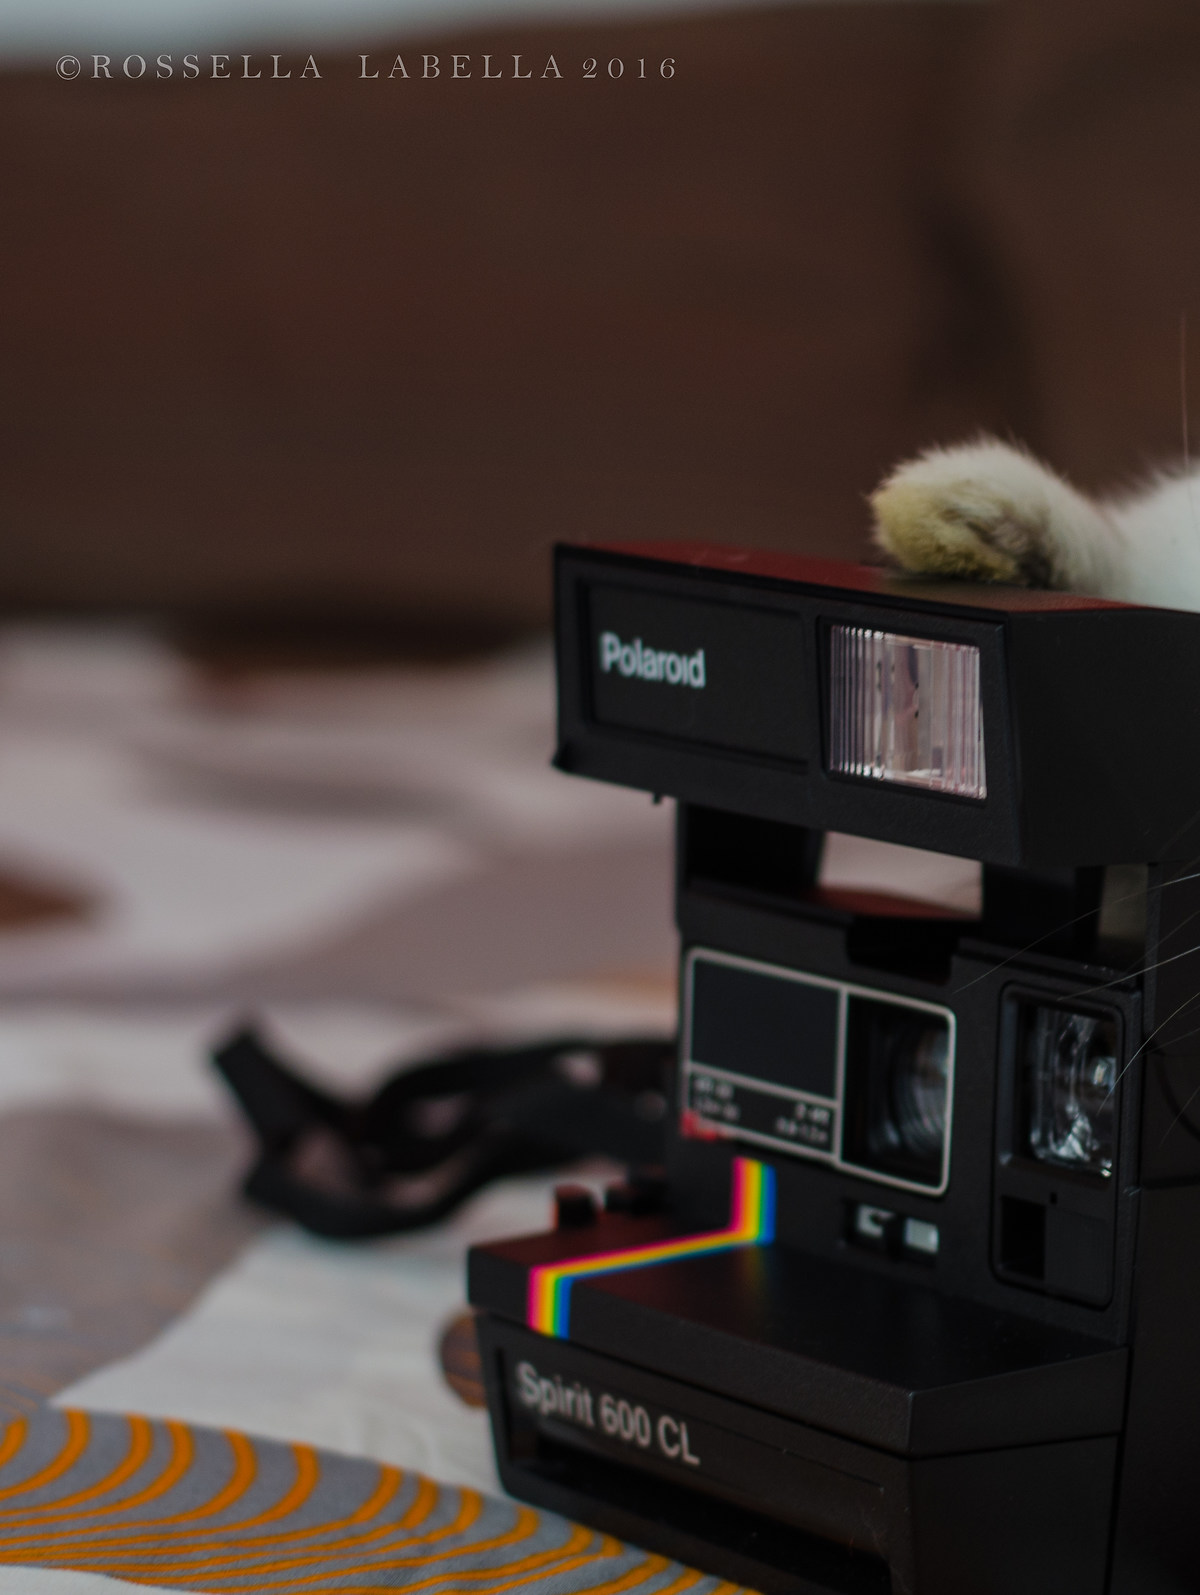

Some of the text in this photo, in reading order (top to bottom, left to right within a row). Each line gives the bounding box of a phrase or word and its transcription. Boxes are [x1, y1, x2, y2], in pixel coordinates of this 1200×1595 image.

[600, 631, 706, 688] Polaroid
[517, 1361, 700, 1466] Spirit 600 CL
